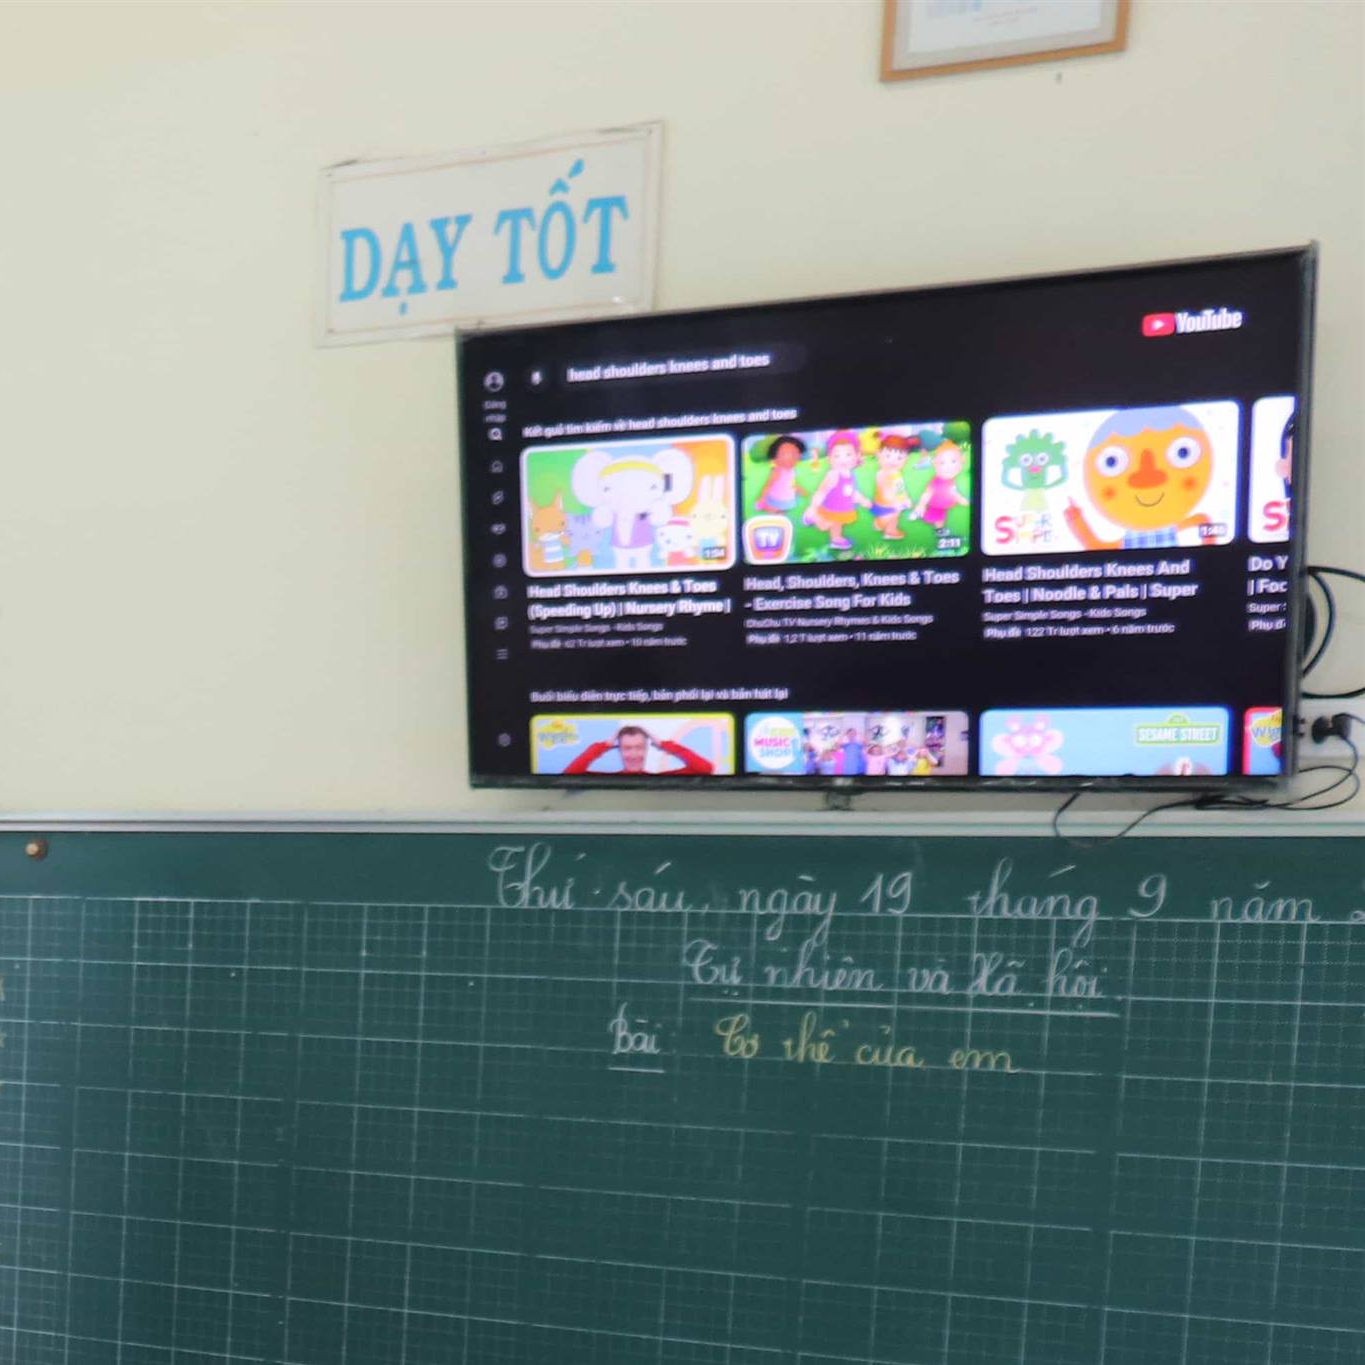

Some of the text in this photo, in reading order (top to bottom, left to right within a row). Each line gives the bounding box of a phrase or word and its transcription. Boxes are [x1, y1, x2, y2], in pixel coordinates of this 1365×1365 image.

[339, 159, 629, 316] DẠY TỐT
[1175, 307, 1243, 334] YouTube
[567, 352, 771, 383] head shoulders knees and toes
[628, 417, 656, 430] head
[657, 413, 711, 429] shoulders
[712, 411, 746, 425] knees
[748, 409, 771, 422] and
[772, 407, 798, 420] toes
[982, 559, 1190, 582] Head Shoulders Knees And
[1248, 556, 1273, 572] Do
[526, 578, 717, 599] Head Shoulders Knees & Toes
[744, 570, 961, 592] Head, Shoulders, Knees & Toes
[753, 592, 912, 613] Exercise Song For Kids
[982, 588, 1021, 604] Toes
[1032, 585, 1086, 602] Noodle
[1088, 584, 1102, 600] &
[1105, 583, 1139, 599] Pals
[1150, 582, 1199, 600] Super
[527, 599, 725, 621] (Speeding Up) Nursery Rhyme
[982, 607, 1147, 623] Super Simple Songs Kids Songs
[1248, 603, 1281, 614] Super
[797, 617, 833, 629] Nursery
[833, 615, 870, 628] Rhymes
[880, 614, 903, 626] Kids
[904, 613, 934, 626] Songs
[1026, 626, 1046, 637] 122
[1081, 626, 1106, 636] xem
[1138, 725, 1217, 742] SESAME STREET
[489, 842, 587, 910] Thứ
[738, 873, 837, 942] ngày
[859, 870, 914, 916] 19
[968, 856, 1100, 949] tháng
[1128, 873, 1168, 919] 9
[1211, 880, 1321, 923] năm
[765, 938, 883, 992] nhiên
[907, 957, 955, 996] và
[855, 1024, 925, 1068] của
[948, 1047, 1022, 1075] em
